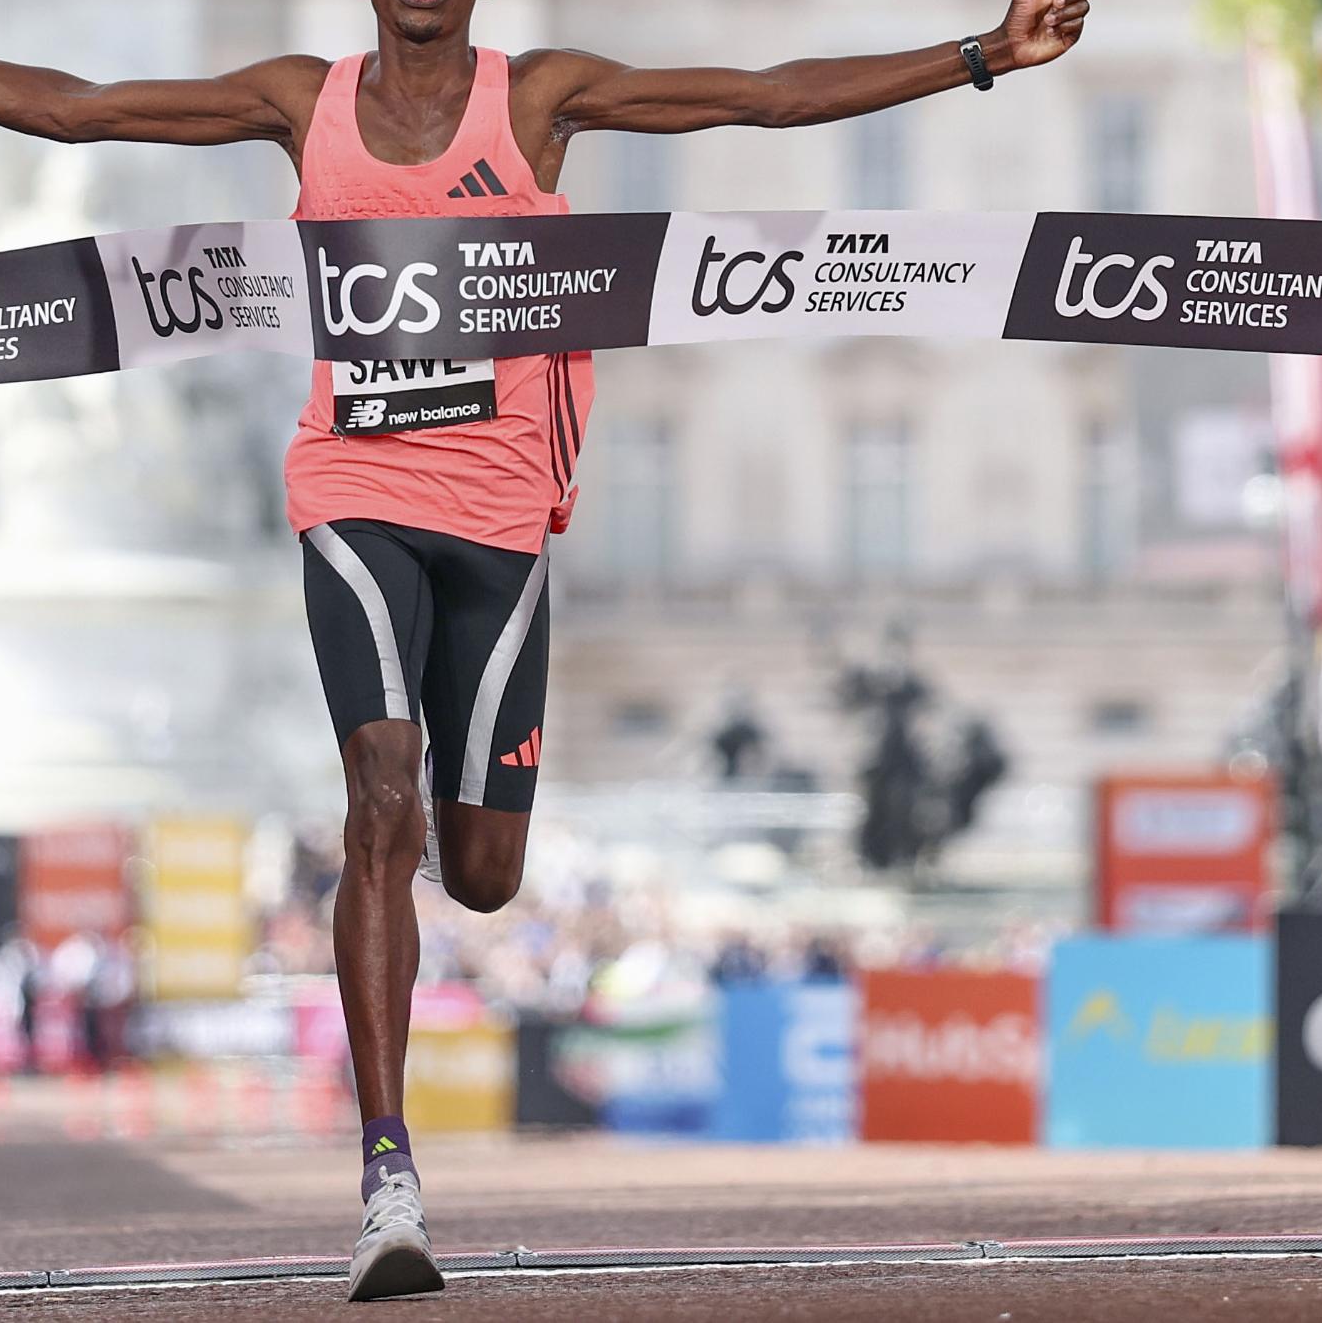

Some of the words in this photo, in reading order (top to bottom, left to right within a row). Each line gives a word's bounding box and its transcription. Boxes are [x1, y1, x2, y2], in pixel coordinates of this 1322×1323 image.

[458, 241, 536, 267] TATA
[826, 234, 889, 254] TATA
[1194, 240, 1263, 265] TATA
[203, 246, 247, 268] TATA
[458, 268, 618, 301] CONSULTANCY
[691, 235, 805, 317] tcs
[814, 261, 976, 285] CONSULTANCY
[1054, 235, 1175, 322] tcs
[131, 256, 224, 338] tcs
[217, 276, 295, 298] CONSULTANCY
[318, 246, 441, 336] tcs
[804, 289, 906, 313] SERVICES
[229, 306, 281, 328] SERVICES
[459, 304, 562, 334] SERVICES
[1179, 300, 1289, 329] SERVICES
[388, 411, 419, 426] new
[420, 402, 481, 422] balance
